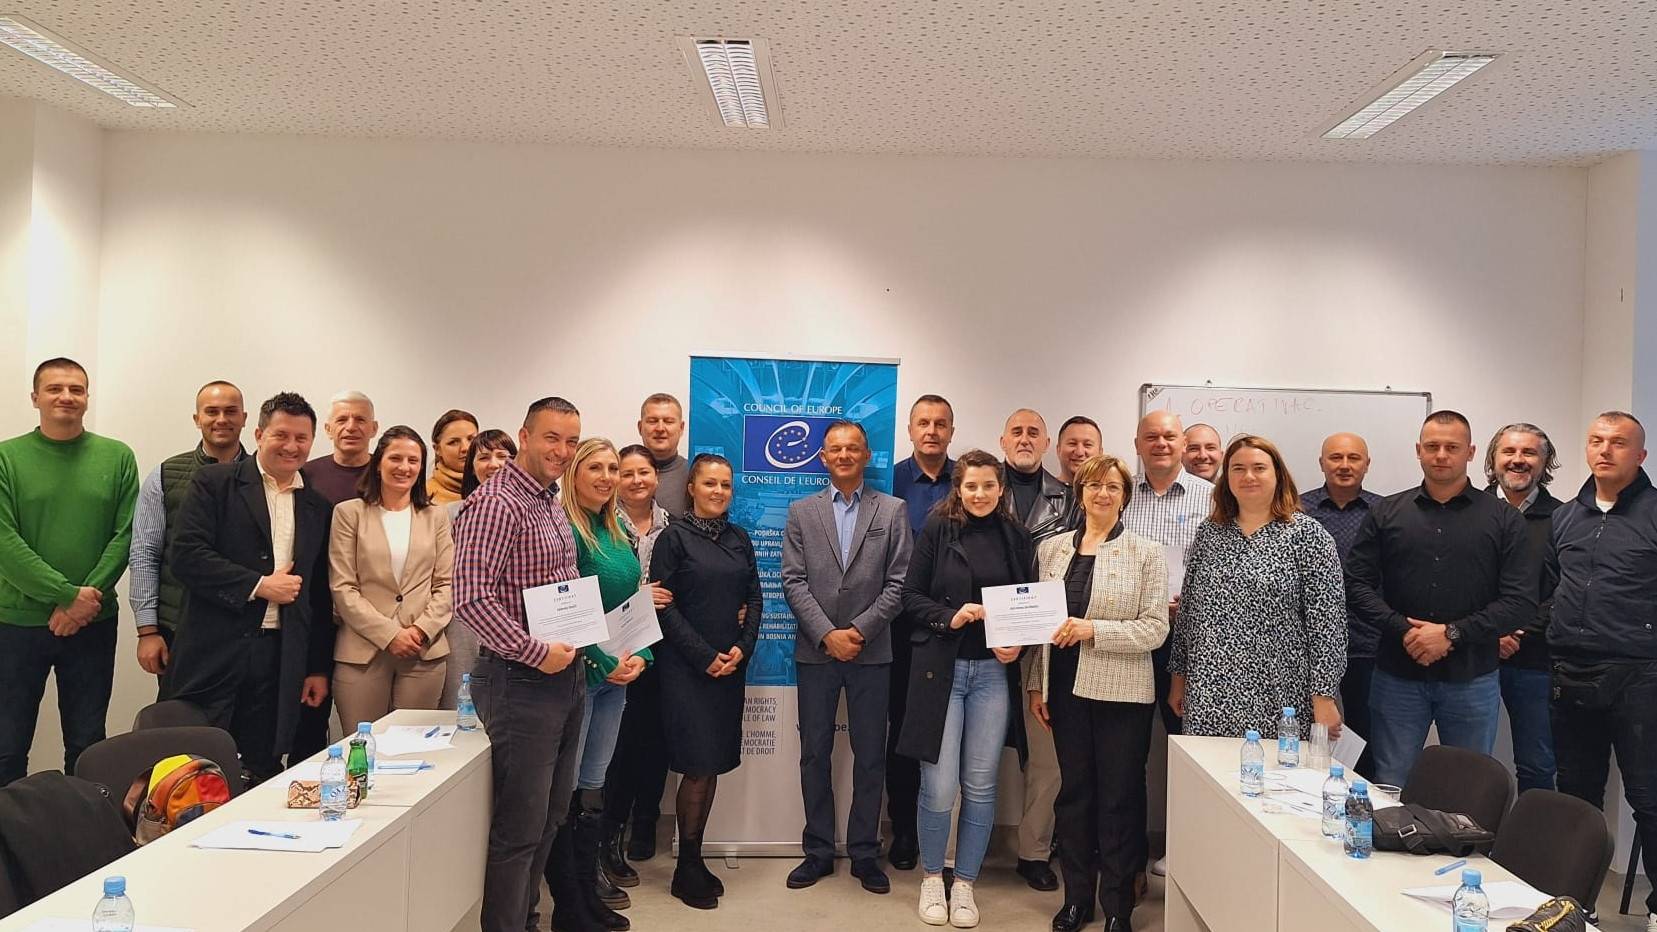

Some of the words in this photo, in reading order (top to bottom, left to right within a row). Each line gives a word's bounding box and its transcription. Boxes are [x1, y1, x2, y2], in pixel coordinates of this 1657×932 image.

[743, 403, 787, 413] COUNCIL
[790, 404, 804, 414] OF
[807, 405, 843, 415] EUROPE
[741, 475, 781, 485] CONSEIL
[784, 476, 796, 485] DE
[799, 477, 830, 486] L'EURO
[745, 697, 753, 705] AN
[745, 705, 776, 713] MOCRACY
[743, 714, 751, 722] LE
[752, 714, 760, 722] OF
[761, 714, 776, 722] LAW
[742, 739, 775, 747] MOCRATIE
[746, 747, 755, 755] DE
[756, 747, 775, 755] DROIT
